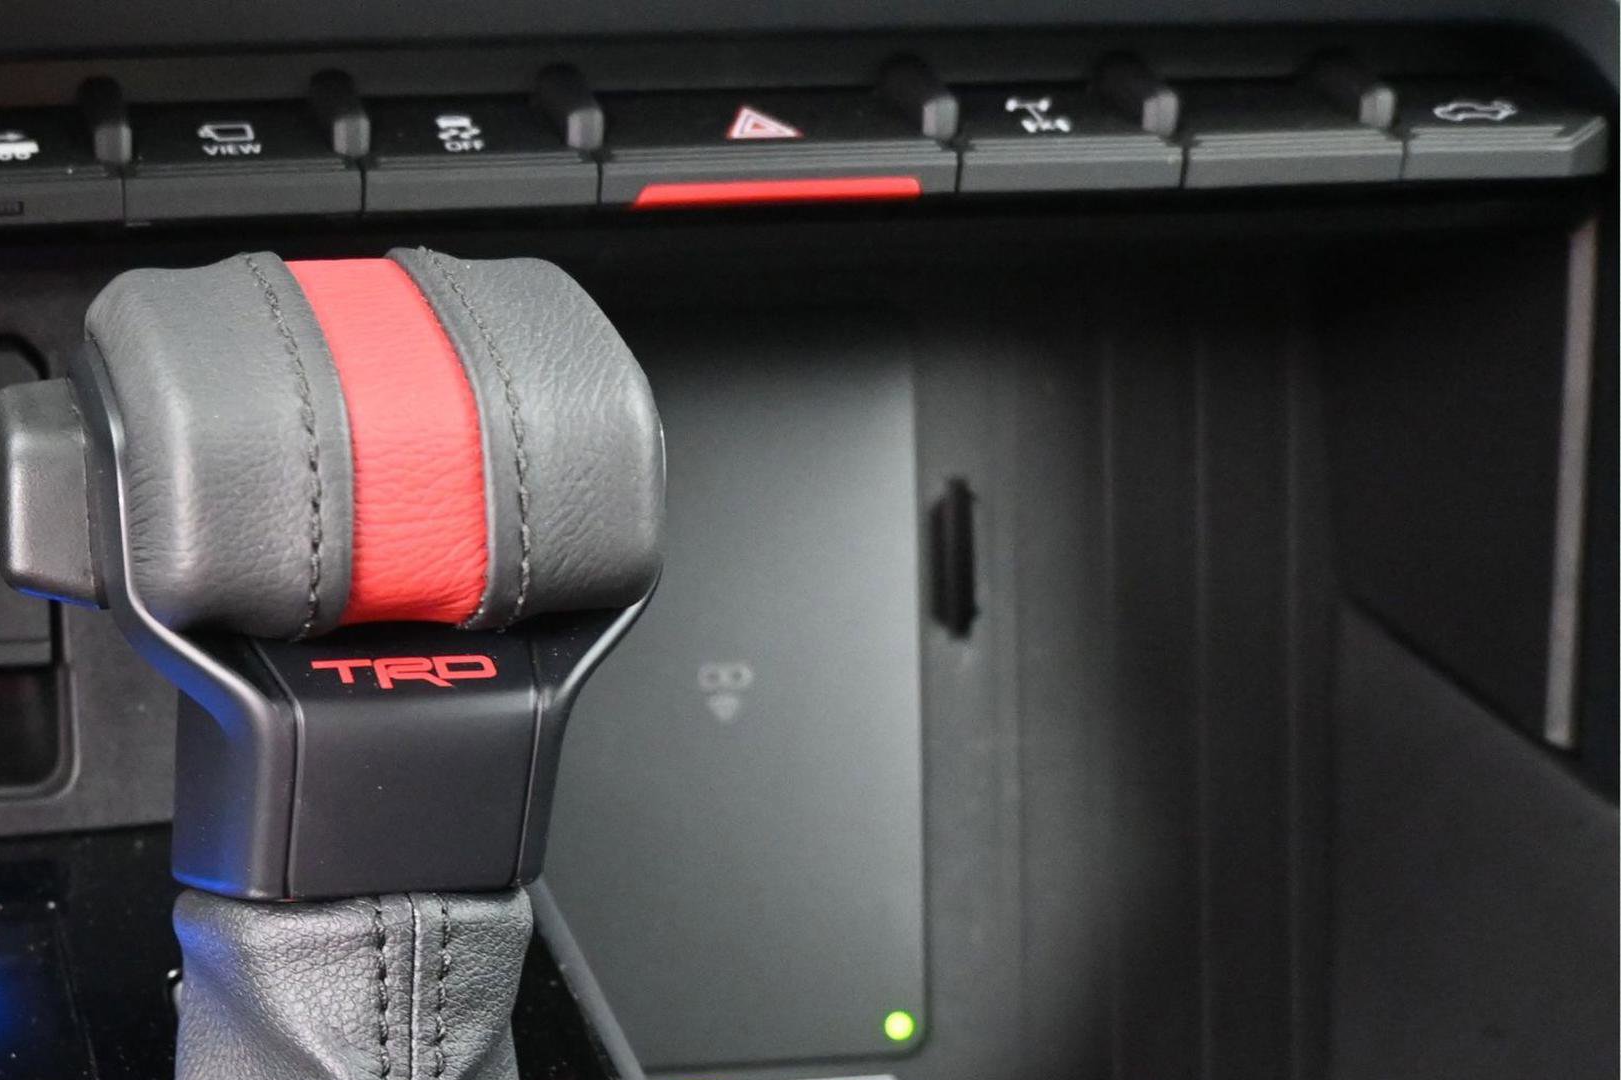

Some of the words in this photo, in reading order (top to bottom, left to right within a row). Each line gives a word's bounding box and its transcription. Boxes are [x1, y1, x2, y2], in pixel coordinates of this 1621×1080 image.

[202, 143, 262, 156] VIEW
[444, 139, 485, 152] OFF
[310, 655, 498, 690] TRD
